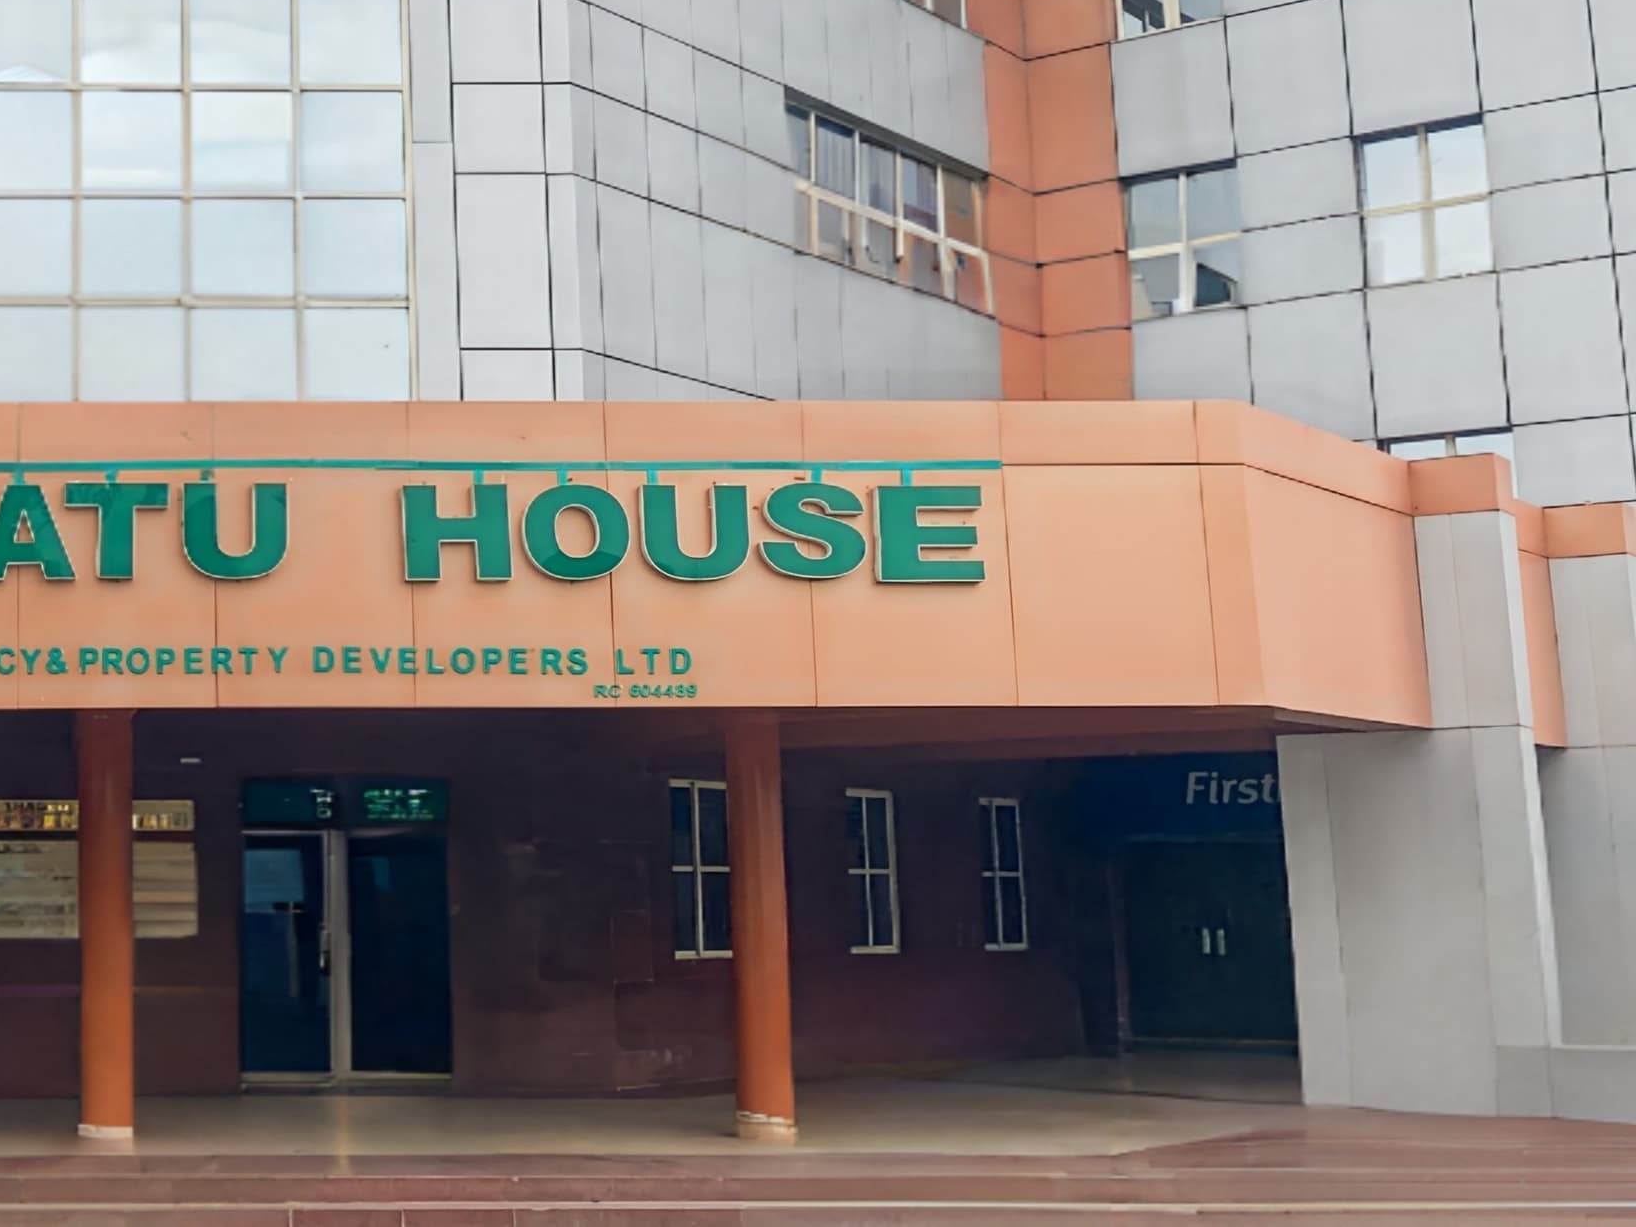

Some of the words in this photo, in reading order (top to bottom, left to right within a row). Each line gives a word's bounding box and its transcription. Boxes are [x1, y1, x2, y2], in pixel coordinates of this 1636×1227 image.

[400, 482, 987, 584] HOUSE
[78, 646, 289, 675] PROPERTY
[312, 646, 589, 676] DEVELOPERS
[614, 647, 693, 676] LTD
[593, 684, 622, 699] RC
[1185, 771, 1281, 805] First
